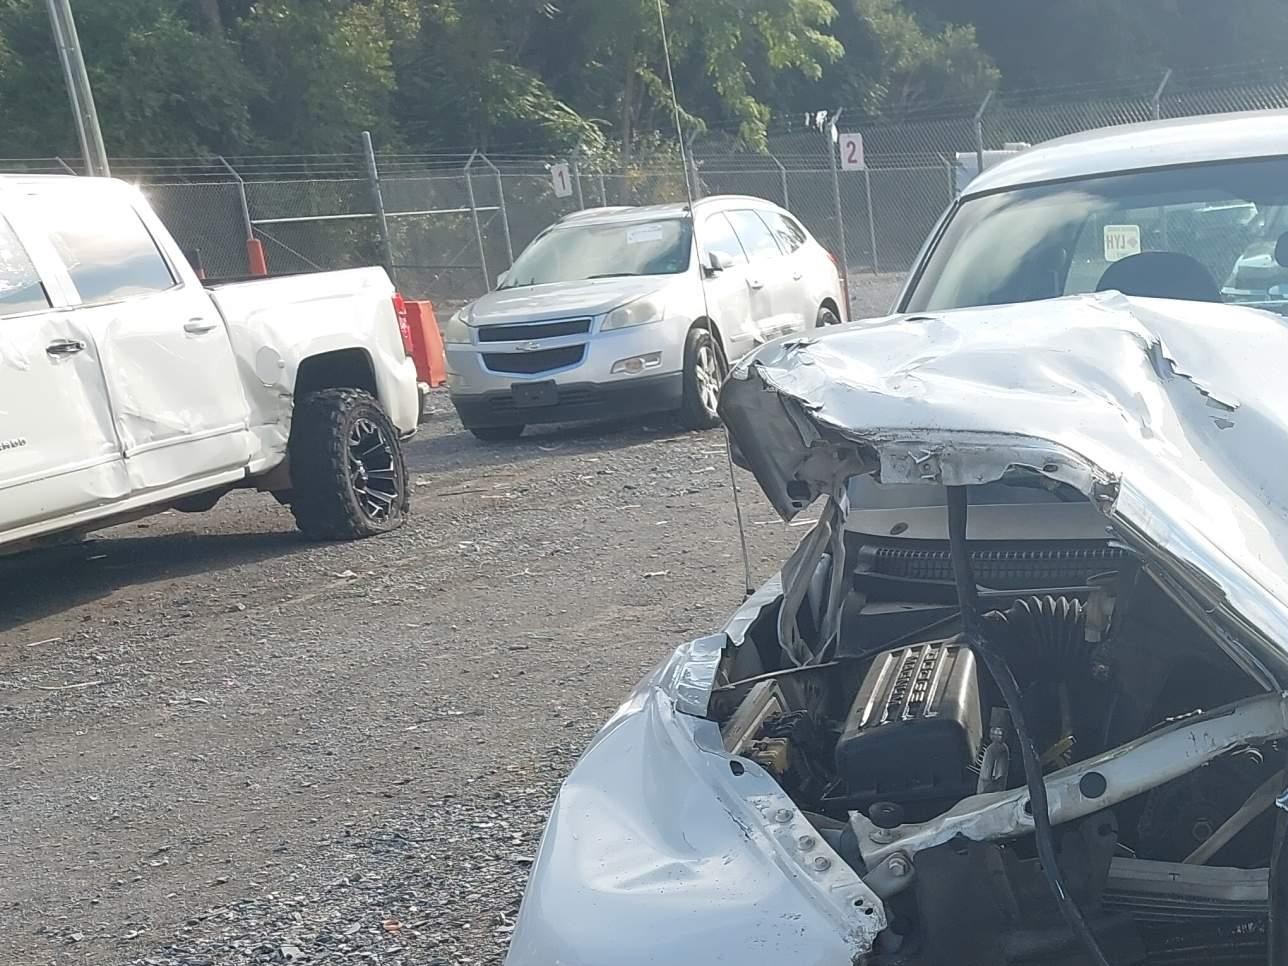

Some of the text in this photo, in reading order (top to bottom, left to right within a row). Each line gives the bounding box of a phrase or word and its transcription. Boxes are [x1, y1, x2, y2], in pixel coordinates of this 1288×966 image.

[846, 140, 858, 164] 2
[888, 654, 919, 705] MAGNUM
[910, 648, 939, 704] DODGE
